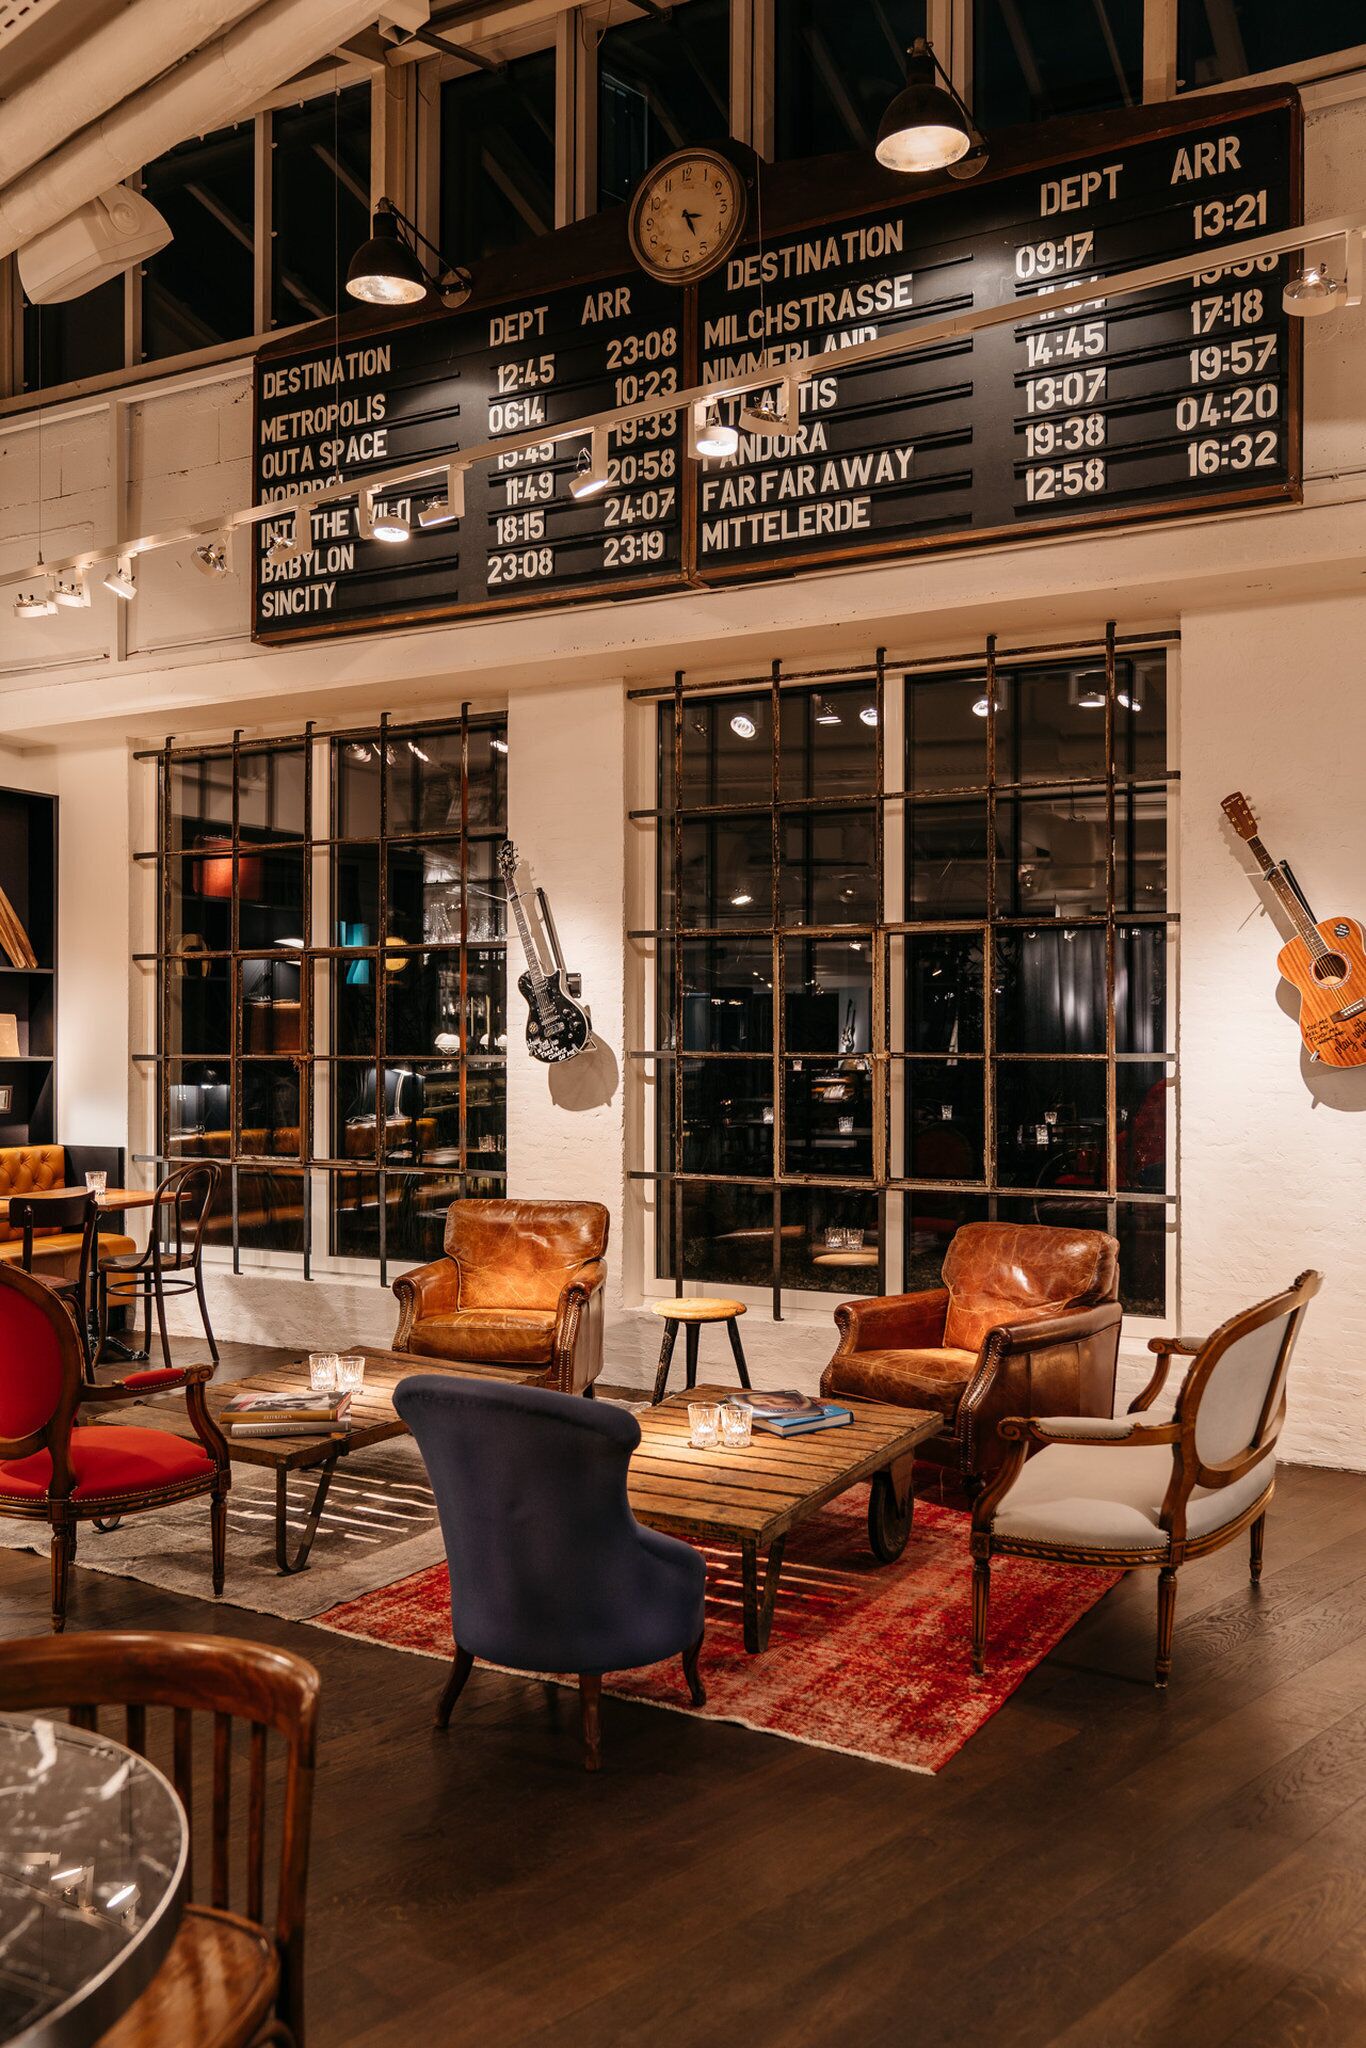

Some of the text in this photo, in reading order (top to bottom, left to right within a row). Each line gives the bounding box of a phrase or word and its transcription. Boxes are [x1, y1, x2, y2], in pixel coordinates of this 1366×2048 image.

[682, 167, 692, 182] 12
[1170, 135, 1241, 185] ARR
[650, 196, 661, 212] 10
[665, 179, 672, 193] 11
[714, 180, 723, 196] 2
[1040, 164, 1123, 217] DEPT
[646, 217, 655, 232] 9
[714, 221, 726, 235] 4
[1193, 190, 1267, 240] 13:21
[649, 234, 658, 249] 8
[664, 249, 672, 263] 7
[682, 249, 691, 263] 6
[699, 241, 708, 255] 5
[727, 220, 904, 291] DESTINATION
[1015, 231, 1094, 278] 09:17
[580, 286, 631, 325] ARR
[703, 273, 913, 350] MILCHSTRASSE
[1190, 288, 1264, 334] 17:18
[489, 306, 549, 347] DEPT
[1026, 320, 1106, 367] 14:45
[606, 327, 677, 370] 23:08
[1189, 333, 1278, 384] 19:57
[263, 345, 391, 399] DESTINATION
[497, 354, 555, 393] 12:45
[615, 367, 677, 407] 10:23
[1025, 367, 1106, 413] 13:07
[261, 394, 386, 445] METROPOLIS
[488, 396, 544, 433] 06:14
[705, 377, 837, 427] ATATIS
[1176, 383, 1278, 431] 04:20
[319, 429, 387, 468] SPACE
[616, 410, 677, 447] 19:33
[702, 421, 828, 472] NDORA
[1025, 413, 1105, 457] 19:38
[606, 448, 676, 488] 20:58
[1188, 431, 1278, 477] 16:32
[506, 471, 554, 506] 11:49
[1025, 458, 1105, 502] 12:58
[604, 487, 675, 527] 24:07
[702, 496, 871, 552] MITTELERDE
[261, 519, 297, 549] INT
[310, 509, 350, 540] THE
[496, 510, 545, 545] 18:15
[261, 543, 354, 584] BABYLON
[487, 547, 553, 584] 23:08
[603, 530, 664, 567] 23:19
[261, 581, 336, 618] SINCITY
